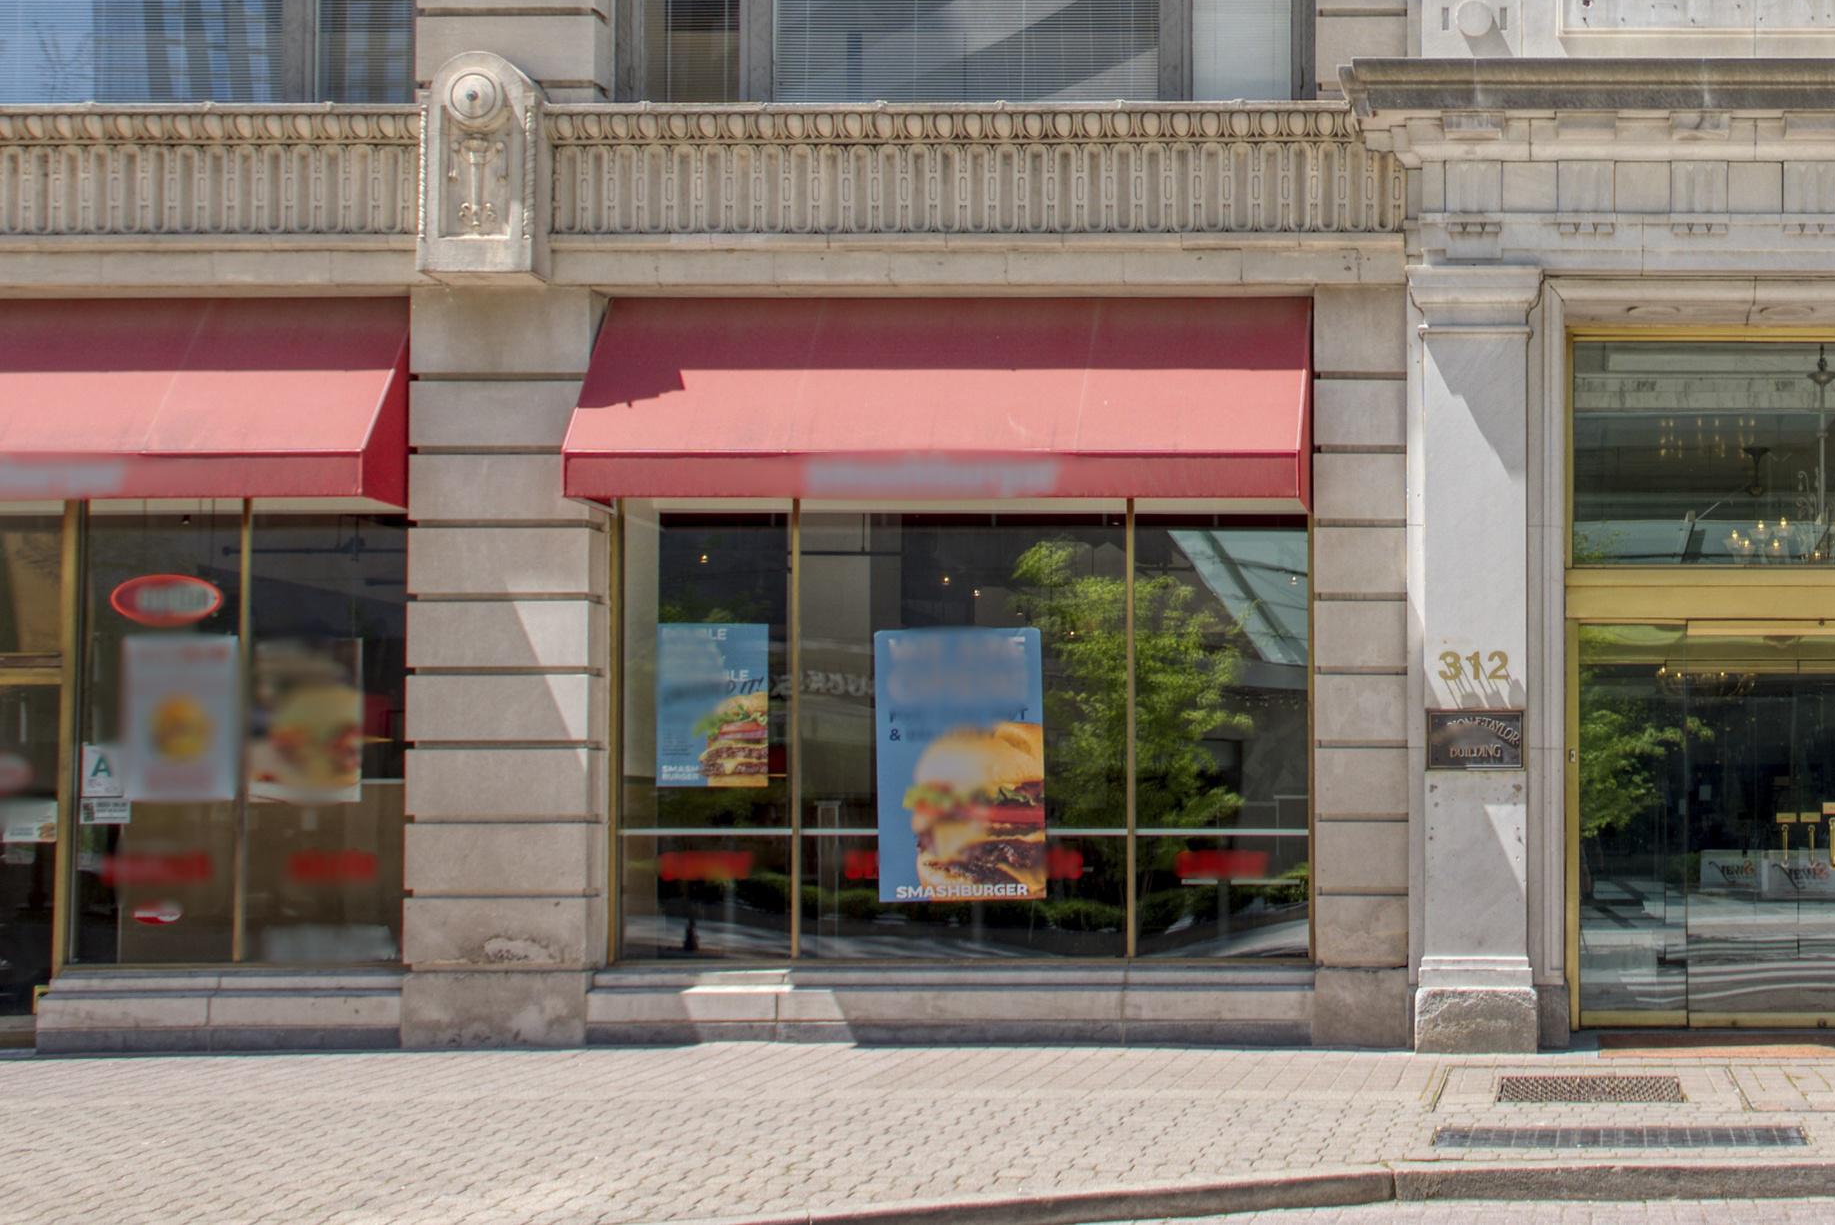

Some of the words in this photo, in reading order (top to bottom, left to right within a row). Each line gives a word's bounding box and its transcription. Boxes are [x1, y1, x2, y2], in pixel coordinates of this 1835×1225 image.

[1438, 650, 1509, 680] 312
[91, 756, 112, 777] A
[896, 883, 1028, 899] SMASHBURGER
